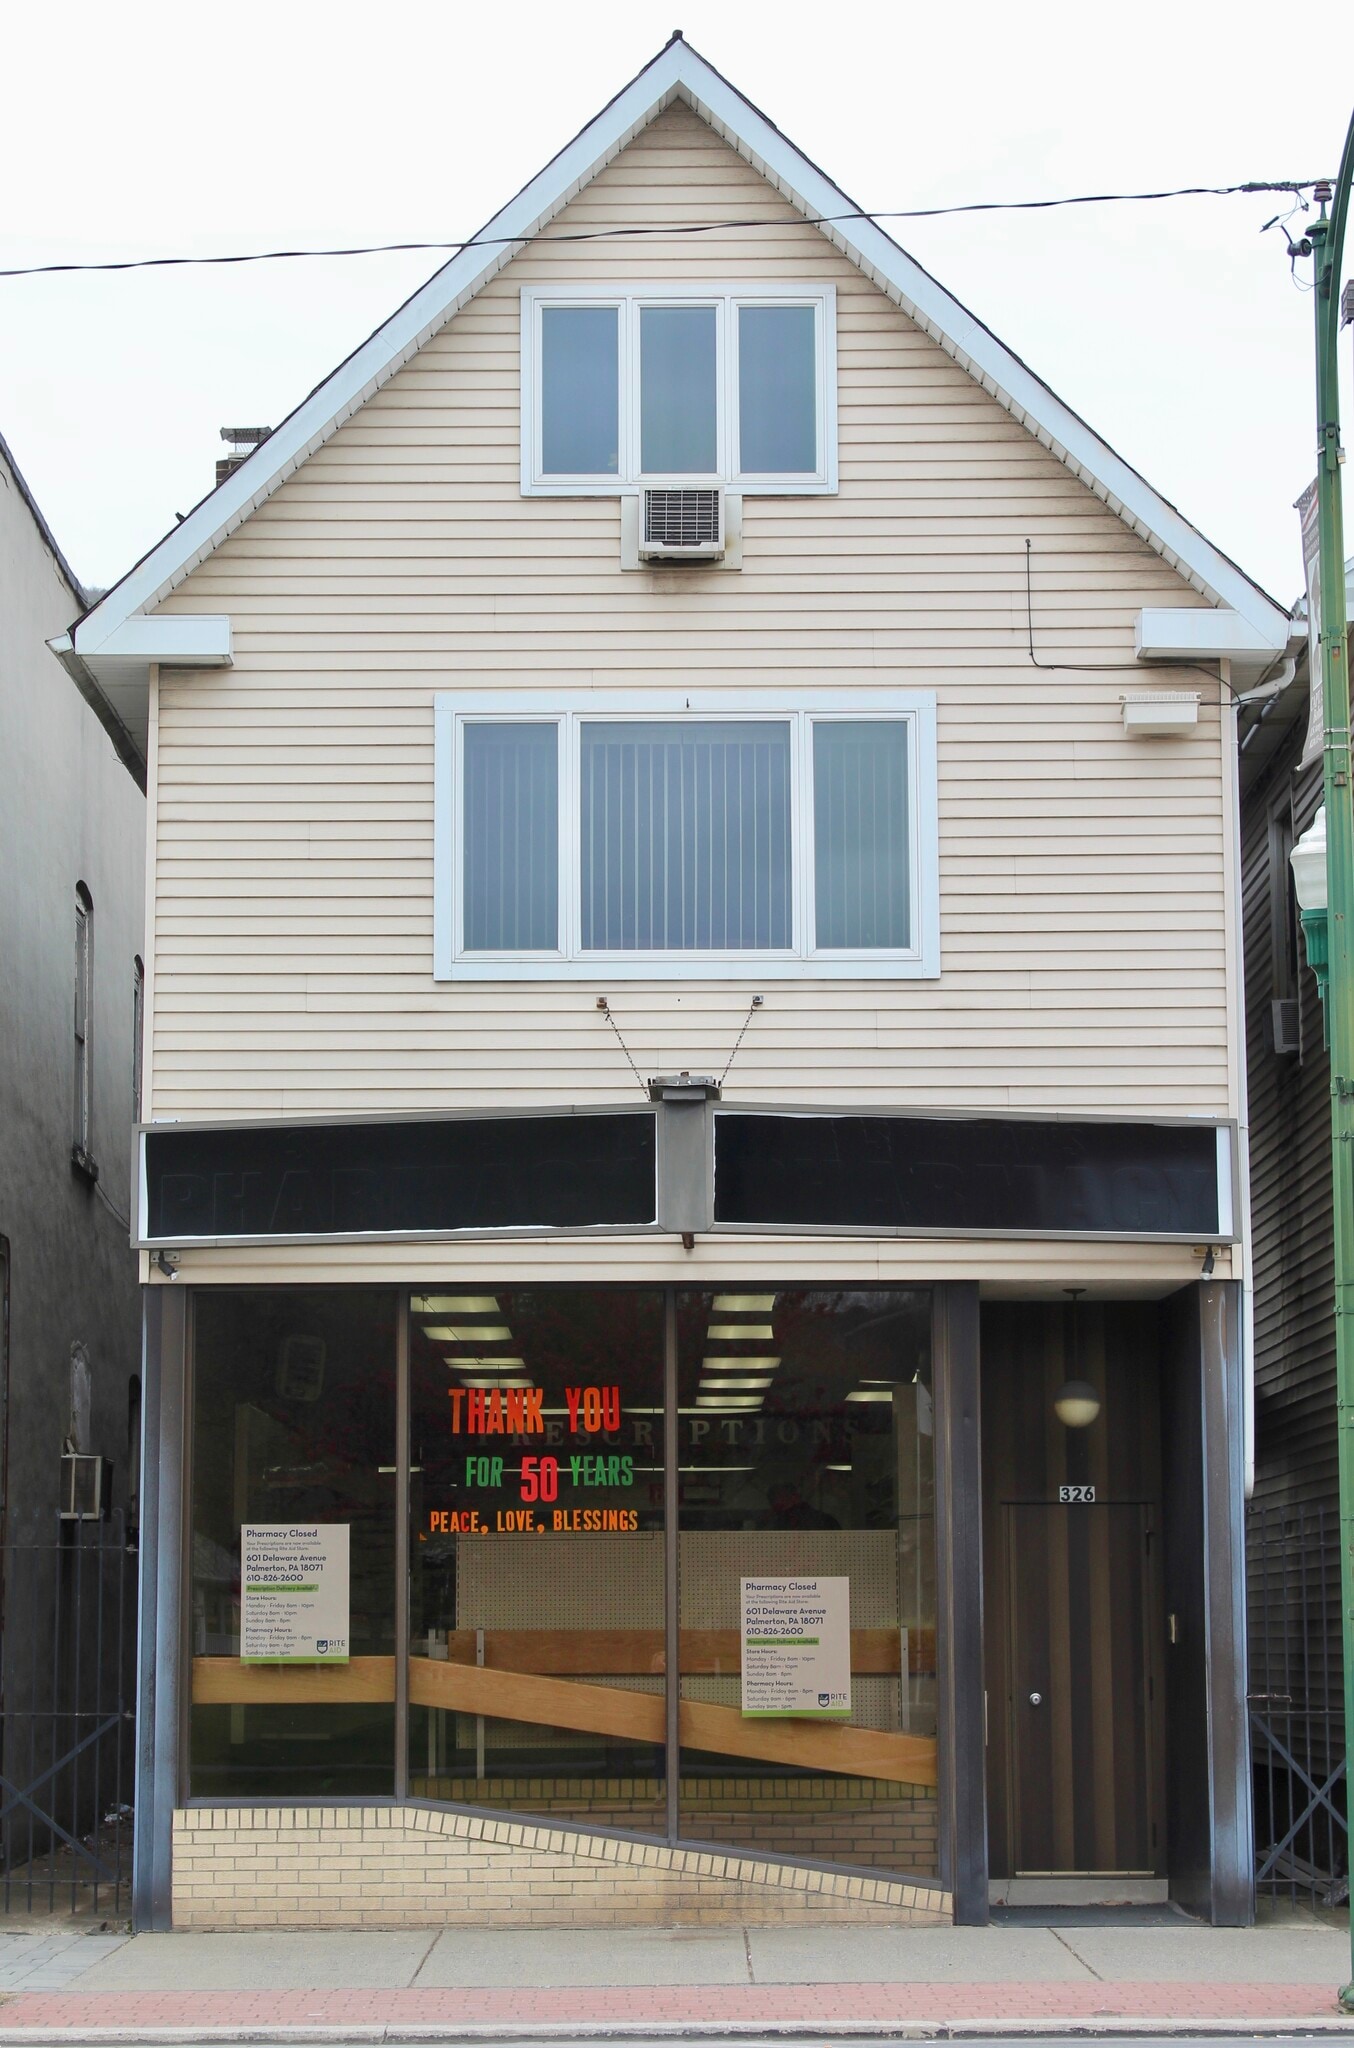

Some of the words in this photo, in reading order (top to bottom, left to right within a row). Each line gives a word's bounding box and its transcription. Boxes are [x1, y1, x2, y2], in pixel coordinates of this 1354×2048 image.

[448, 1388, 544, 1434] THANK
[565, 1386, 620, 1433] YOU
[477, 1419, 859, 1447] RESCRPTIONS
[466, 1456, 503, 1487] FOR
[520, 1456, 559, 1503] 50
[570, 1455, 633, 1487] YEARS
[1061, 1487, 1094, 1501] 326
[247, 1529, 287, 1539] Pharmacy
[289, 1529, 317, 1538] Closed
[430, 1511, 489, 1534] PEACE,
[497, 1510, 545, 1534] LOVE,
[553, 1509, 638, 1531] BLESSINGS
[746, 1582, 787, 1592] Pharmacy
[788, 1582, 817, 1590] Closed
